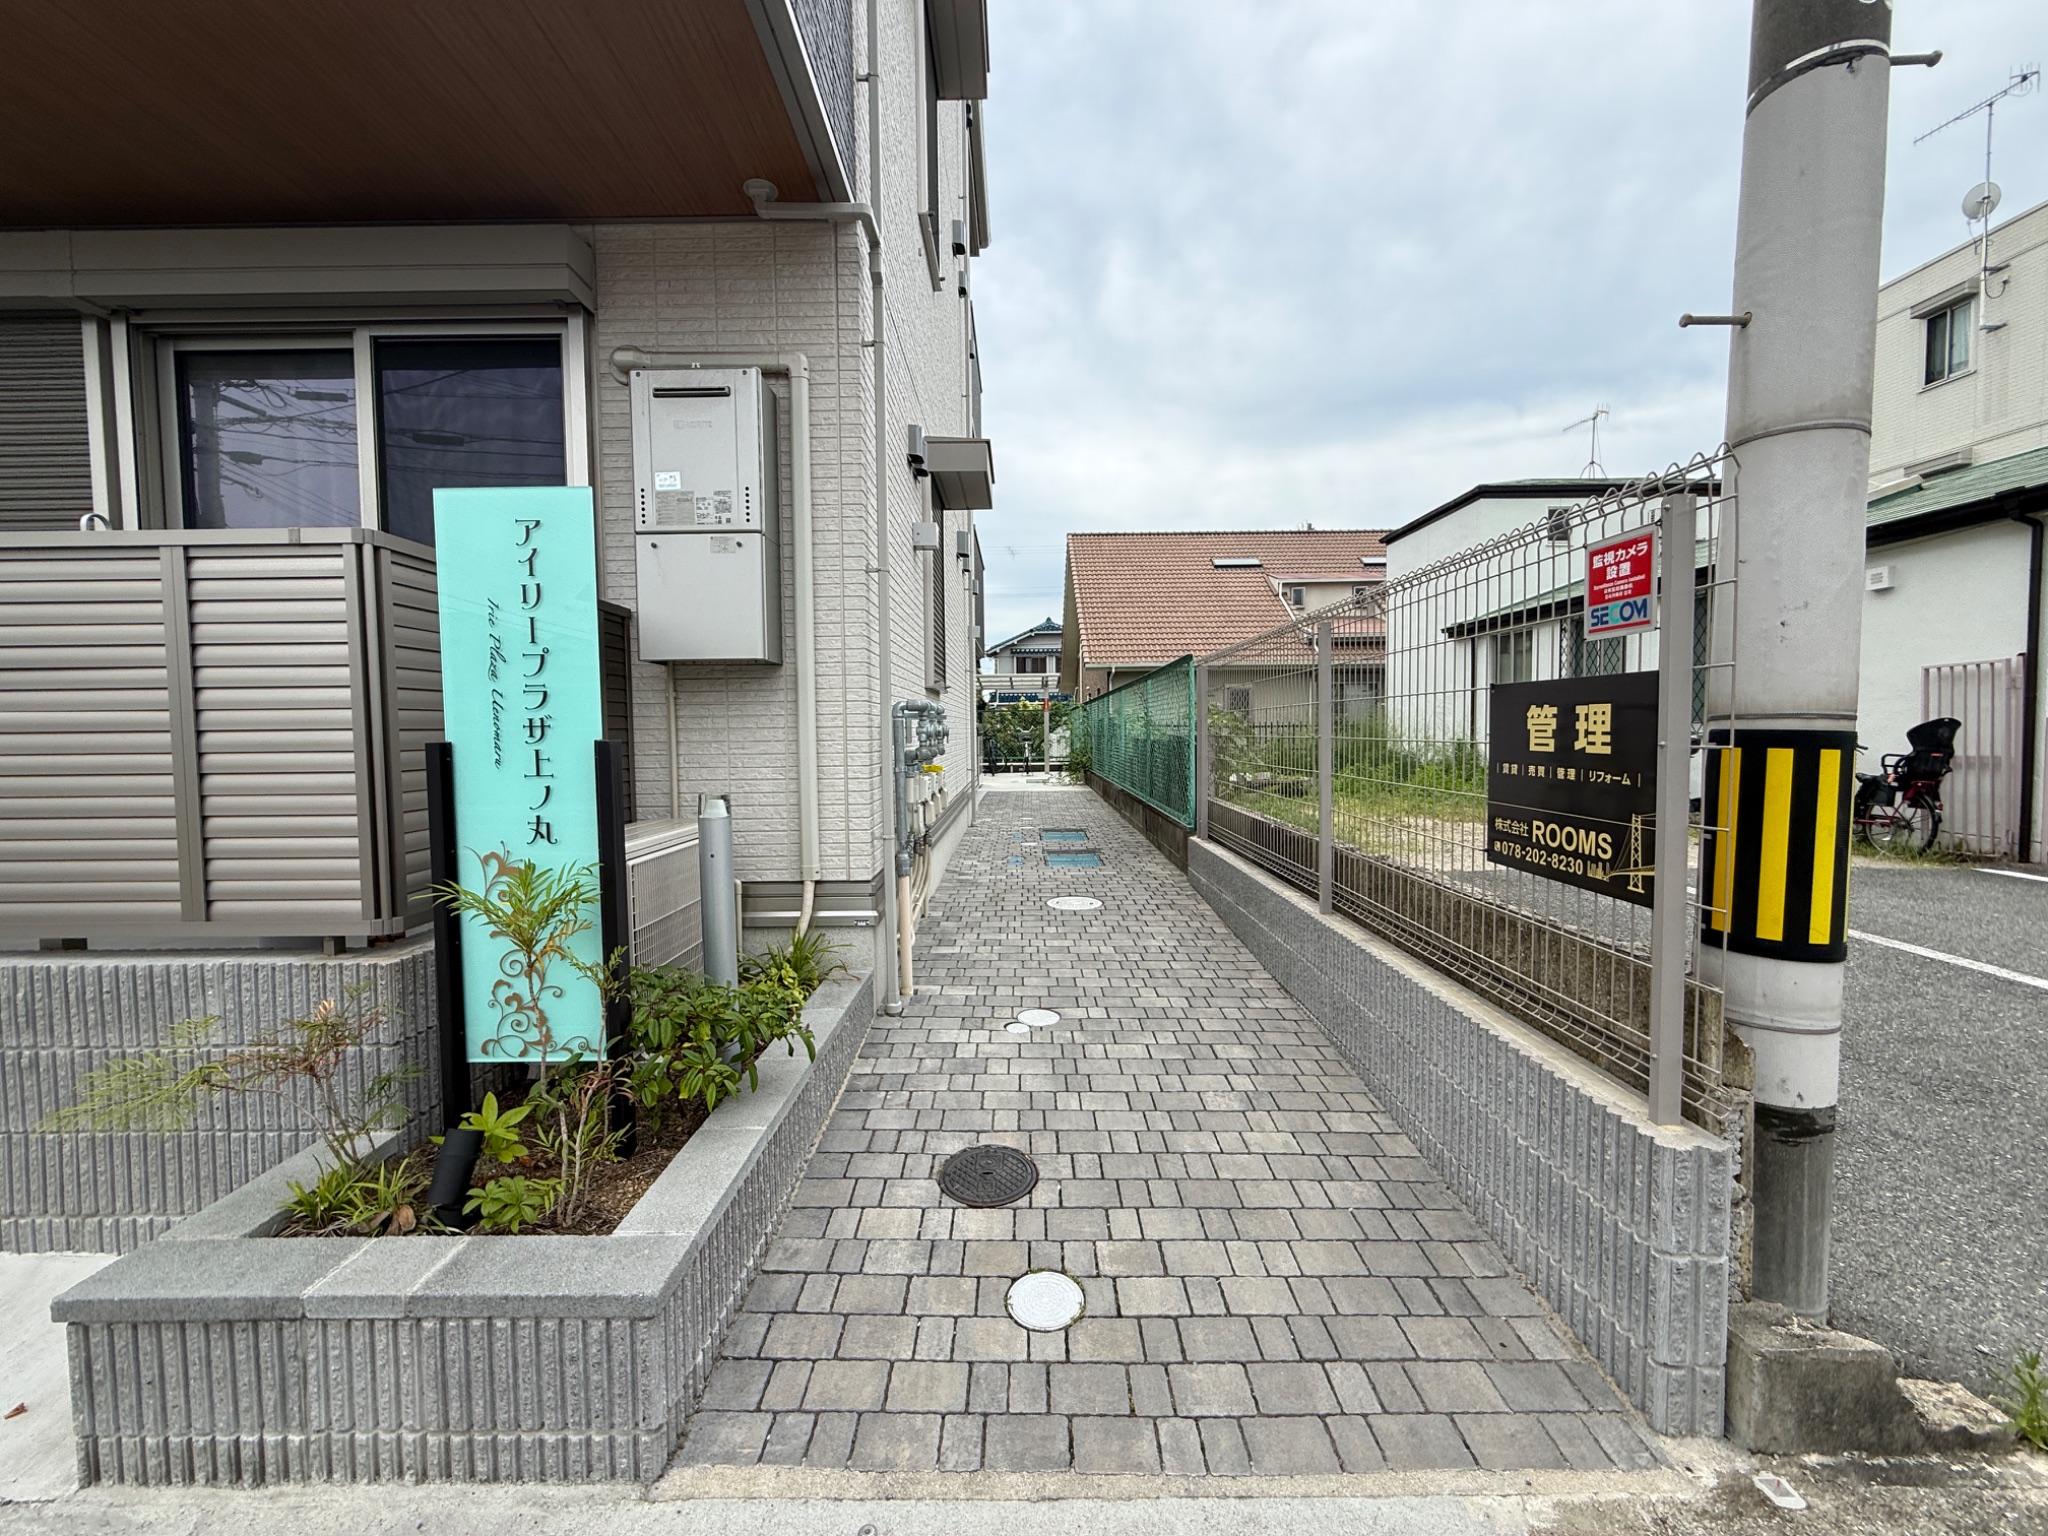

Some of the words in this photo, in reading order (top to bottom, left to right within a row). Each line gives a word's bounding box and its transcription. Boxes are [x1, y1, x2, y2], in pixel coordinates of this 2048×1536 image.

[1592, 541, 1648, 569] 監視カメラ
[1606, 561, 1631, 580] 設置
[487, 597, 500, 628] Irie
[1590, 598, 1648, 627] SECOM
[487, 633, 507, 683] Plaza
[514, 518, 558, 846] アイリープラザ上ノ丸
[491, 688, 504, 770] Uenomaru
[1526, 703, 1612, 755] 管理
[1502, 762, 1519, 776] 賃貸
[1528, 765, 1546, 778] 売買
[1556, 767, 1577, 780] 管理
[1588, 770, 1632, 786] リフォーム
[1494, 816, 1529, 838] 株式会社
[1532, 819, 1613, 860] ROOMS
[1501, 841, 1584, 876] 078-202-8230
